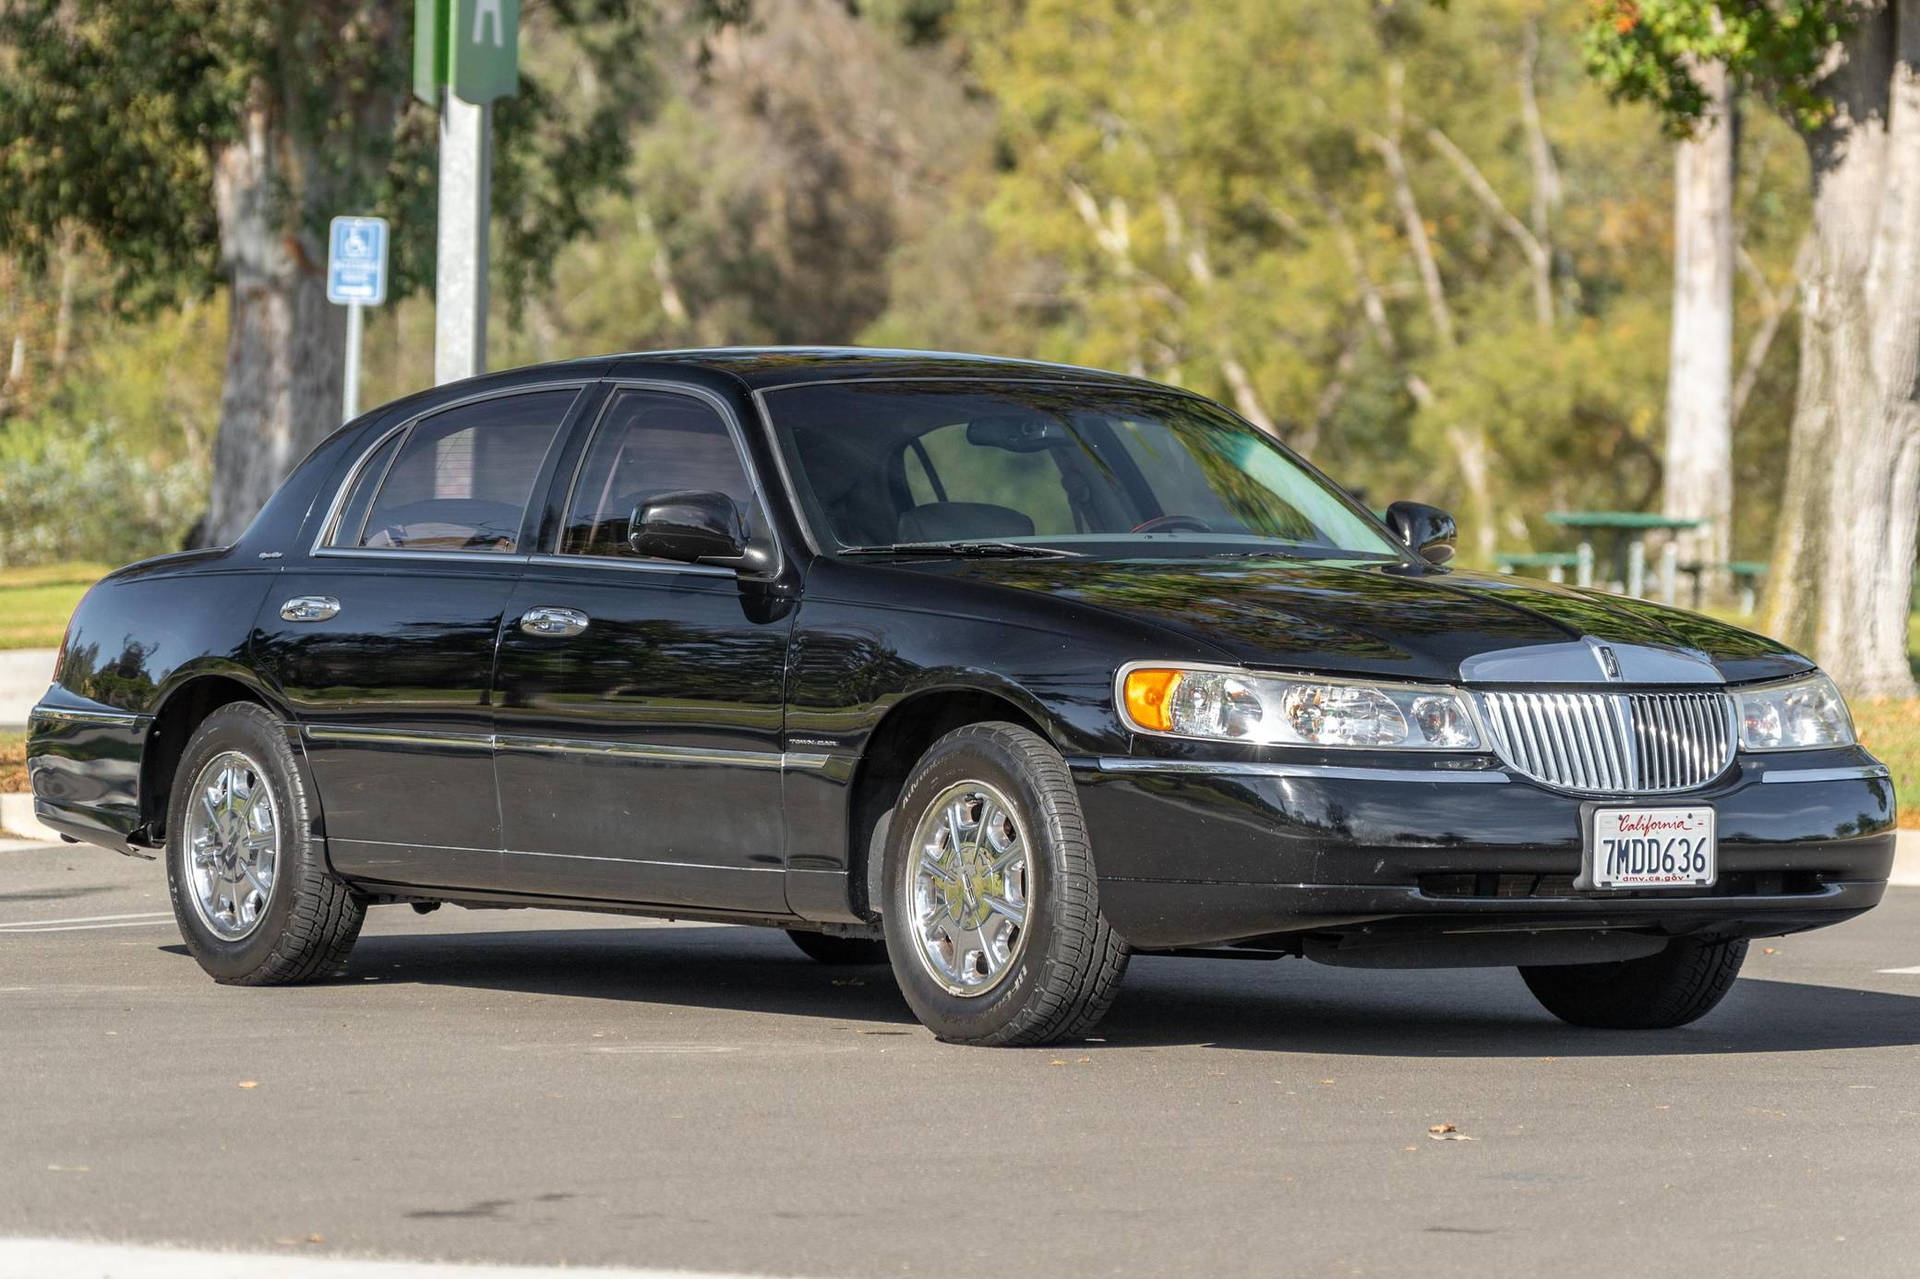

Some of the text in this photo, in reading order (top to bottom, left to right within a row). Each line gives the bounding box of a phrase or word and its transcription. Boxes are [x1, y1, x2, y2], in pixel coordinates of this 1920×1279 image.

[1619, 814, 1693, 837] California
[1603, 837, 1706, 875] 7MDD636
[1622, 873, 1684, 883] dmv.ca.gov
